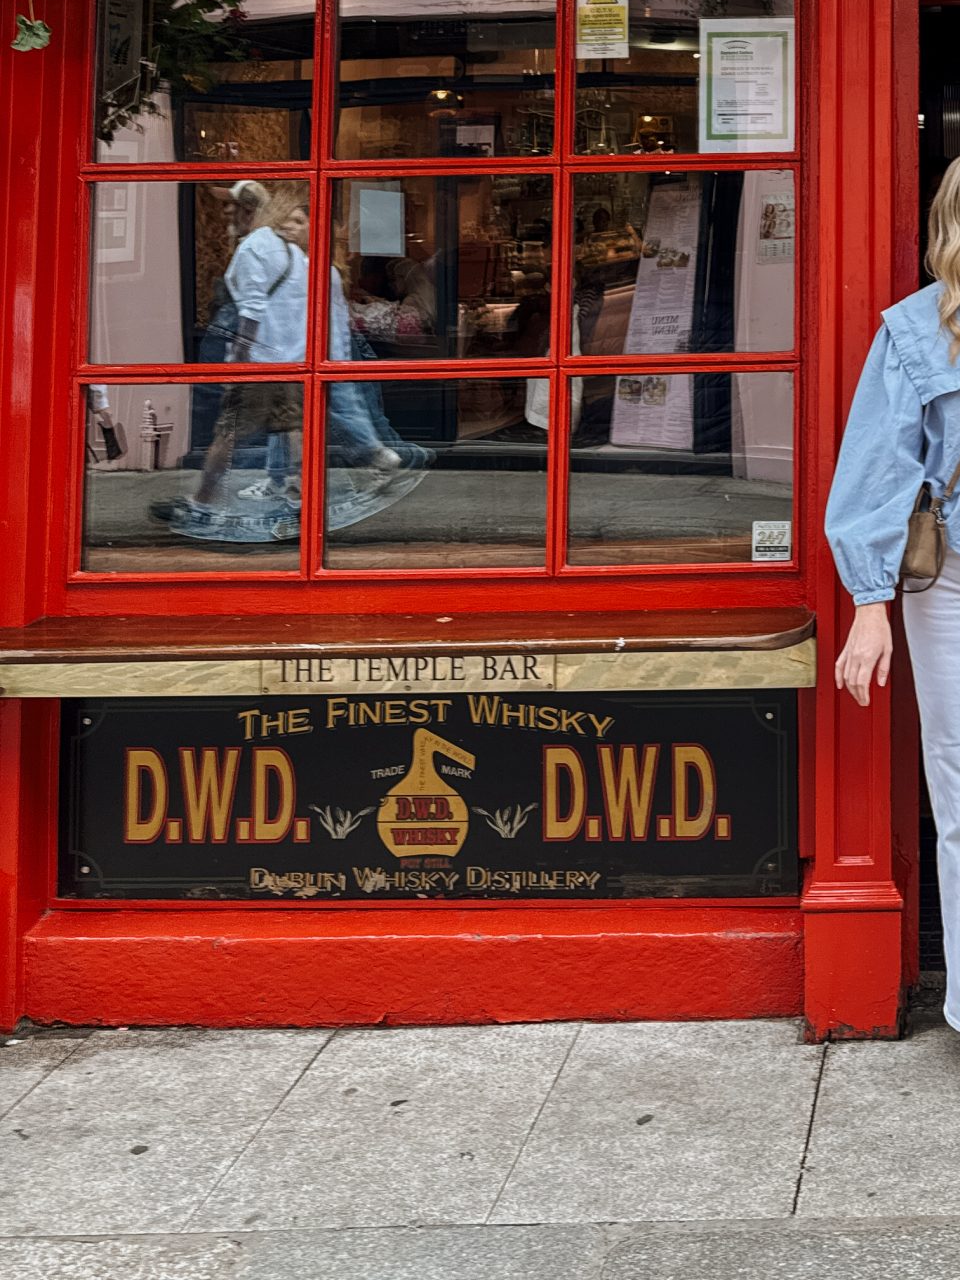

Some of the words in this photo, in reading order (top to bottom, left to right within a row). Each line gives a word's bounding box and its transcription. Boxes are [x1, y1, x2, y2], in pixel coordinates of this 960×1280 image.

[279, 658, 335, 683] THE
[350, 656, 466, 682] TEMPLE
[481, 655, 541, 680] BAR
[237, 708, 314, 741] THE
[325, 696, 454, 730] FINEST
[466, 694, 615, 740] WHISKY
[370, 765, 405, 779] TRADE
[441, 764, 472, 779] MARK
[124, 746, 311, 844] D.W.D.
[542, 742, 732, 842] D.W.D.
[395, 797, 454, 821] D.W.D.
[390, 827, 461, 846] WHISKY
[352, 867, 460, 891] WHISKY
[466, 866, 601, 891] DISTILLERY
